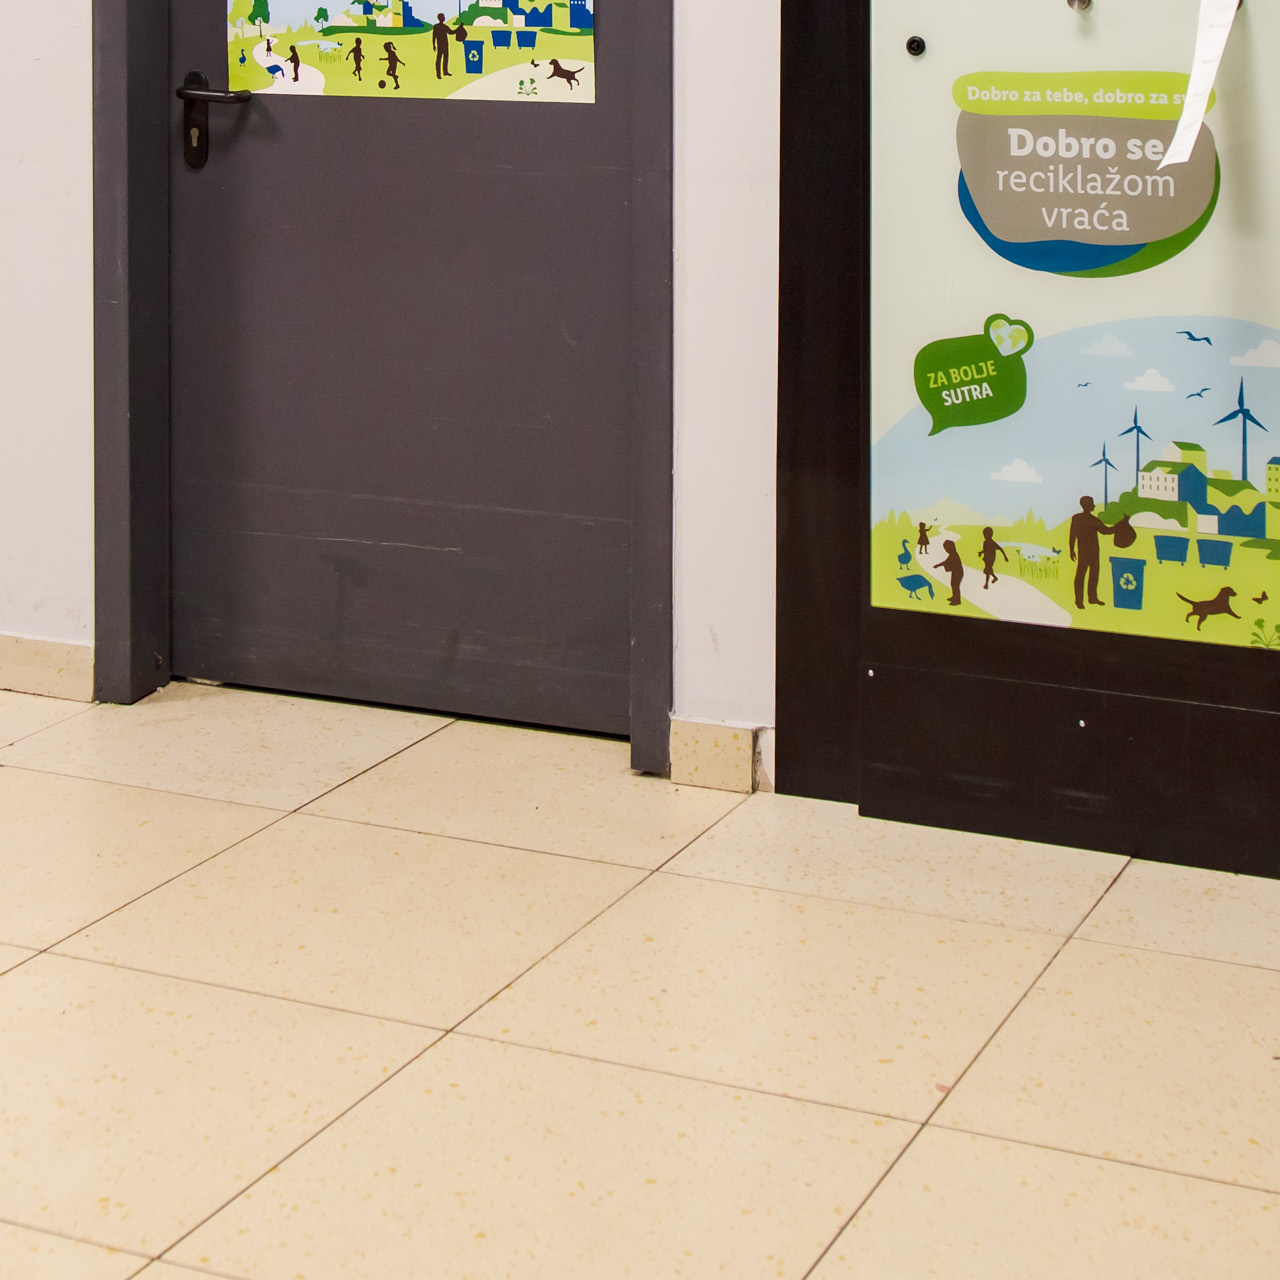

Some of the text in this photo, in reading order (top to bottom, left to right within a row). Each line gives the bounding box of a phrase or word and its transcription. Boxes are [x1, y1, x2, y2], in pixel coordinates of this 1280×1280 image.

[967, 86, 1019, 101] Dobro
[1023, 90, 1042, 102] za
[1045, 87, 1089, 105] tebe,
[1092, 88, 1145, 104] dobro
[1149, 93, 1169, 105] za
[1008, 128, 1166, 161] Dobro se
[996, 163, 1175, 197] reciklažom
[1041, 201, 1130, 232] vraća
[928, 360, 997, 389] ZA BOLJE
[941, 382, 994, 406] SUTRA
